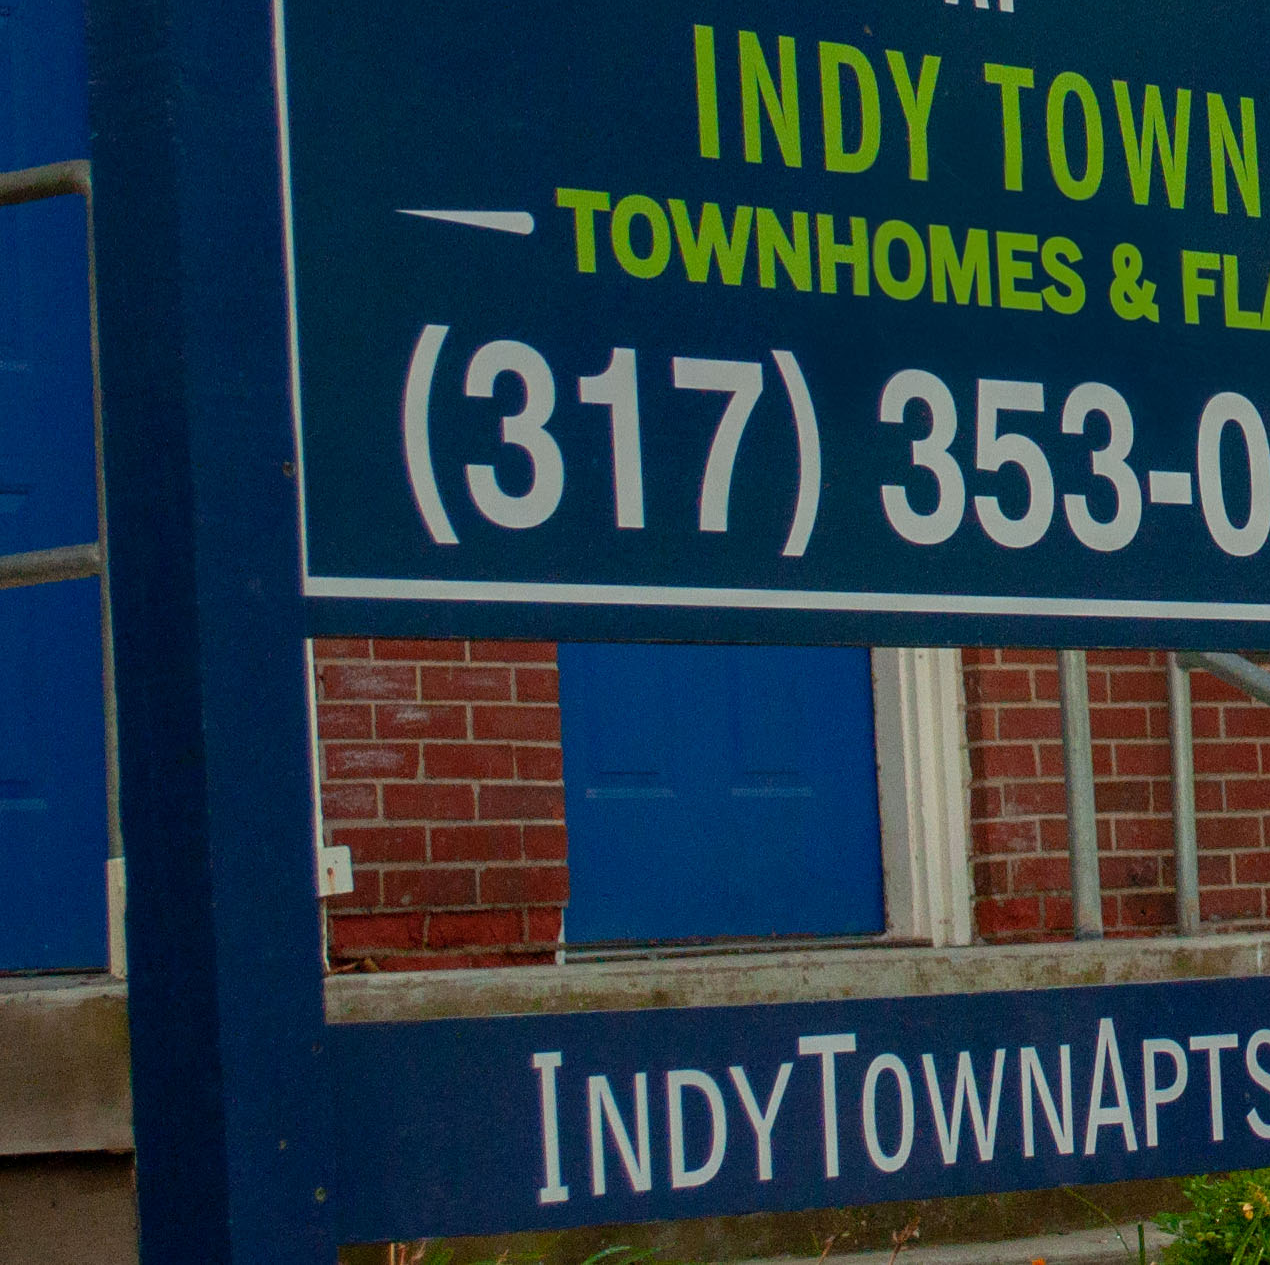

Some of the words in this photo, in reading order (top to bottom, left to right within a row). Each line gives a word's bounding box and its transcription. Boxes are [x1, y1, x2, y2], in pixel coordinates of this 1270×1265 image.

[694, 23, 942, 182] INDY
[983, 62, 1262, 218] TOWN
[556, 187, 1086, 315] TOWNHOMES
[1109, 242, 1160, 323] &
[404, 323, 822, 557] (317)
